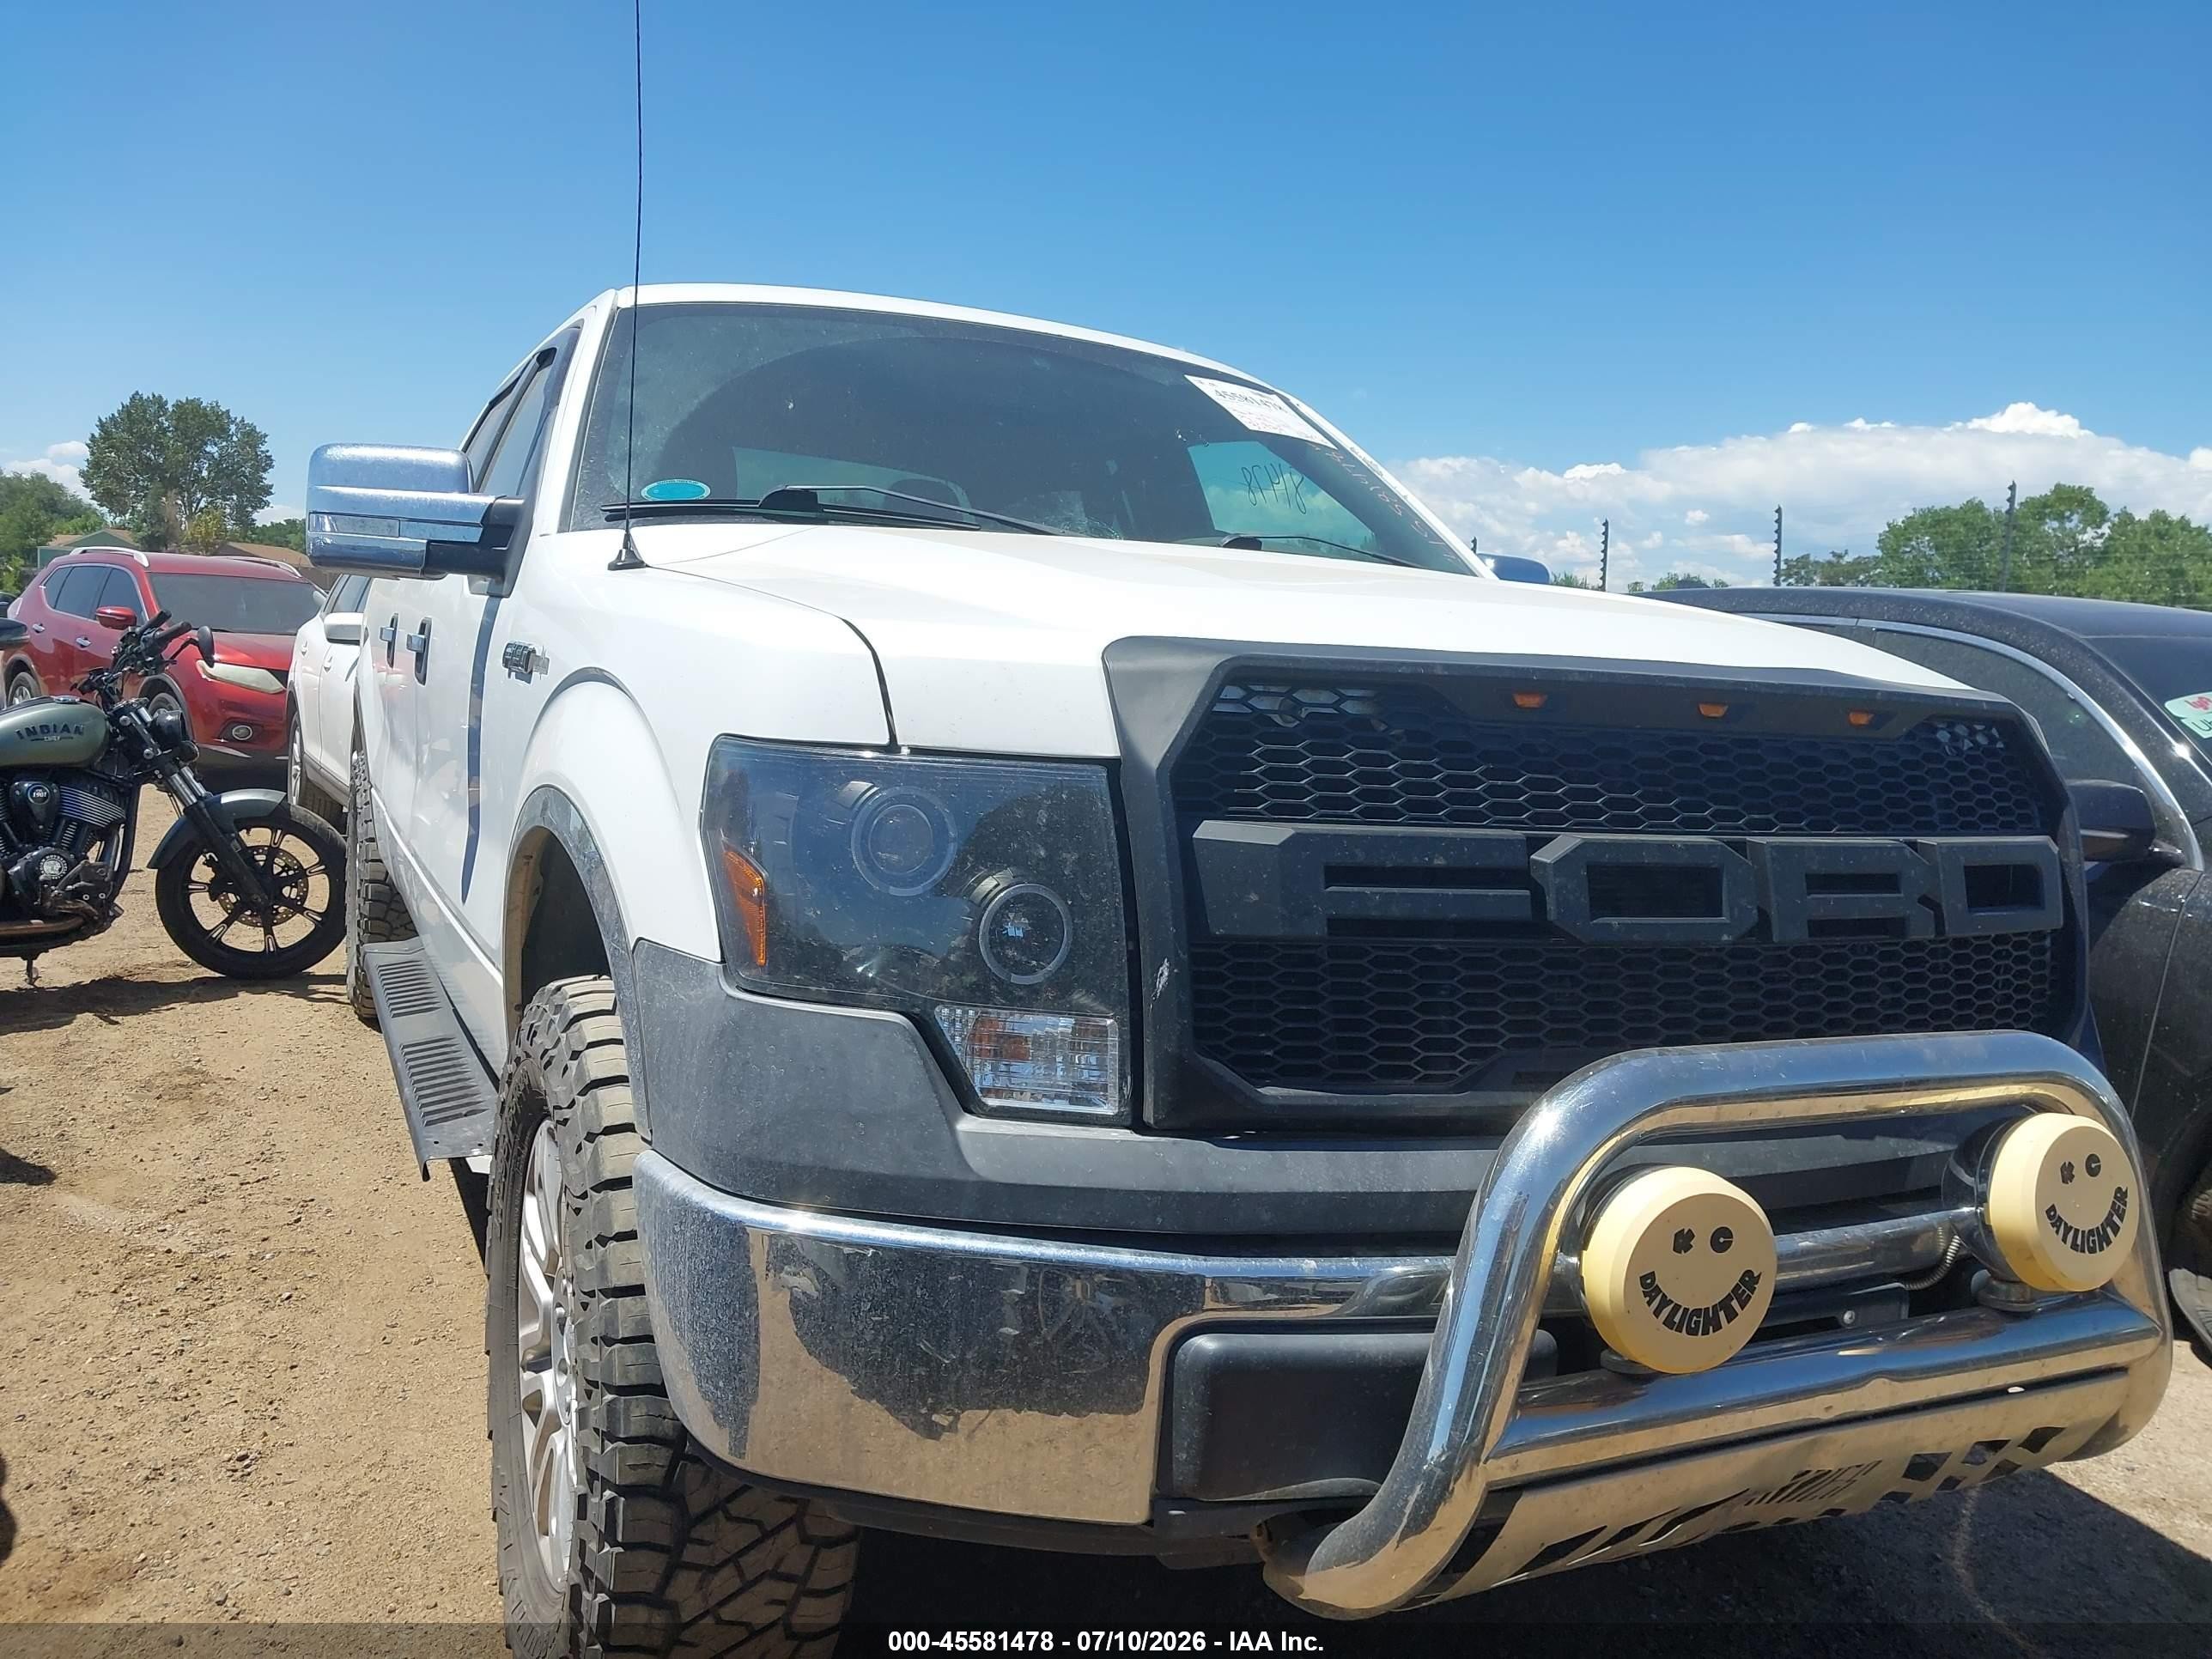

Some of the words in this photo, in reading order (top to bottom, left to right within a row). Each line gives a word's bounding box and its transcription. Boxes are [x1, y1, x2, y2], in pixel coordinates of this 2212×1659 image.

[15, 723, 84, 739] INDIAN
[1194, 820, 2063, 941] FORD
[2045, 1186, 2128, 1254] DAYLIGHTER
[1639, 1269, 1761, 1336] DAYLIGHTER
